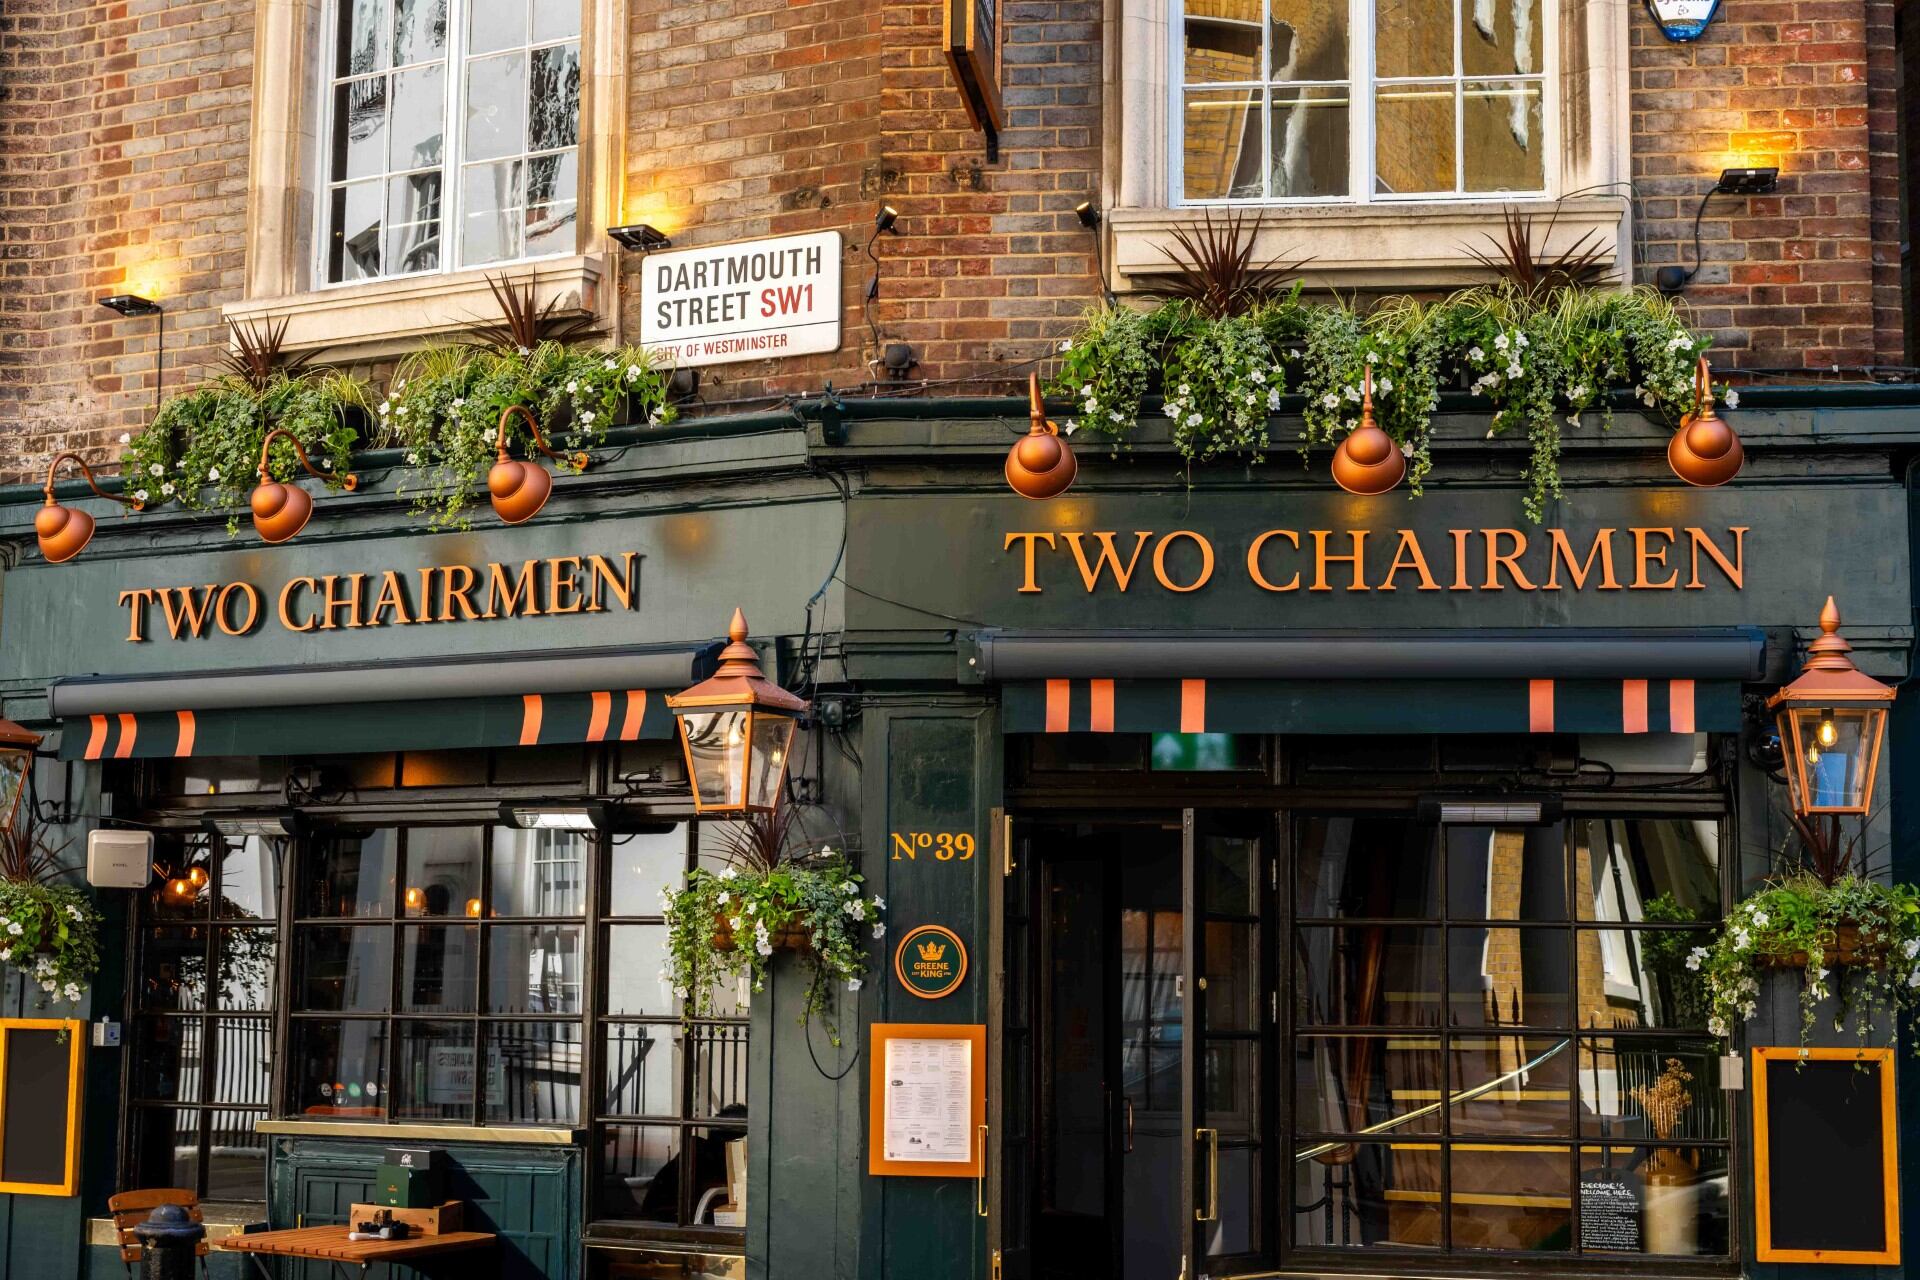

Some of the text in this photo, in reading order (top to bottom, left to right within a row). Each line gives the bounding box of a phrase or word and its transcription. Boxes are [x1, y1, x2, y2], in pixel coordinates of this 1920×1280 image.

[657, 246, 821, 294] DARTMOUTH
[657, 284, 813, 329] STREET SW1
[656, 333, 788, 361] CITY OF WESTMINSTER
[1004, 527, 1750, 593] TWO CHAIRMEN
[118, 552, 638, 642] TWO CHAIRMEN
[914, 962, 949, 970] GREENE
[920, 970, 943, 978] KING
